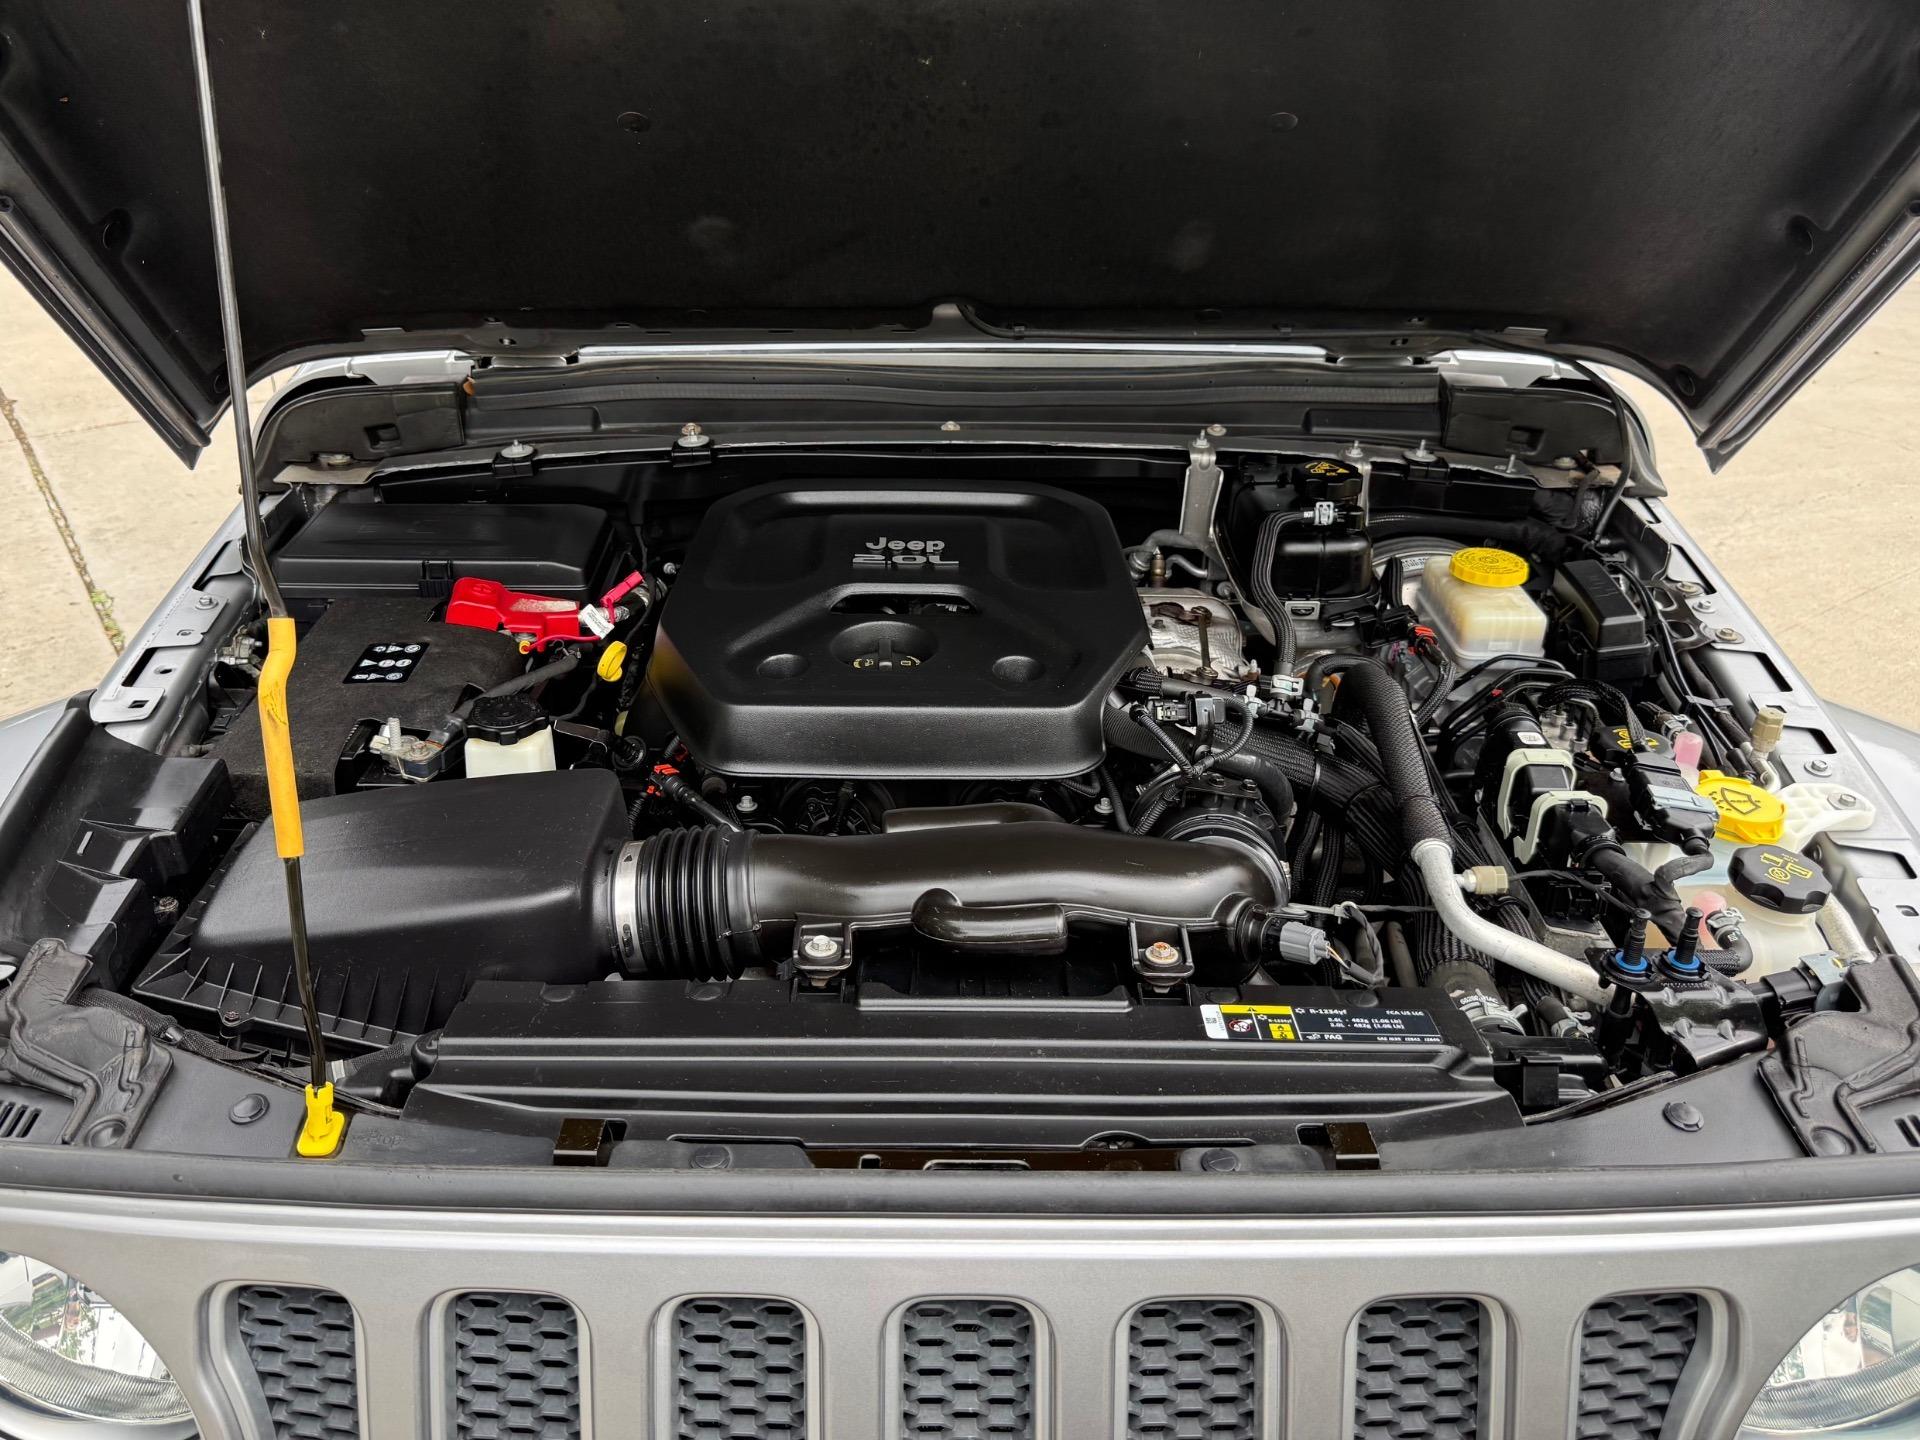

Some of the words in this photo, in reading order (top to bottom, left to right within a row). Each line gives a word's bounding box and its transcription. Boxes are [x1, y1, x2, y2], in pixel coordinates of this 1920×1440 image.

[865, 536, 945, 553] Jeep
[852, 553, 959, 564] 2.0L
[1309, 1008, 1347, 1016] R-1234yf
